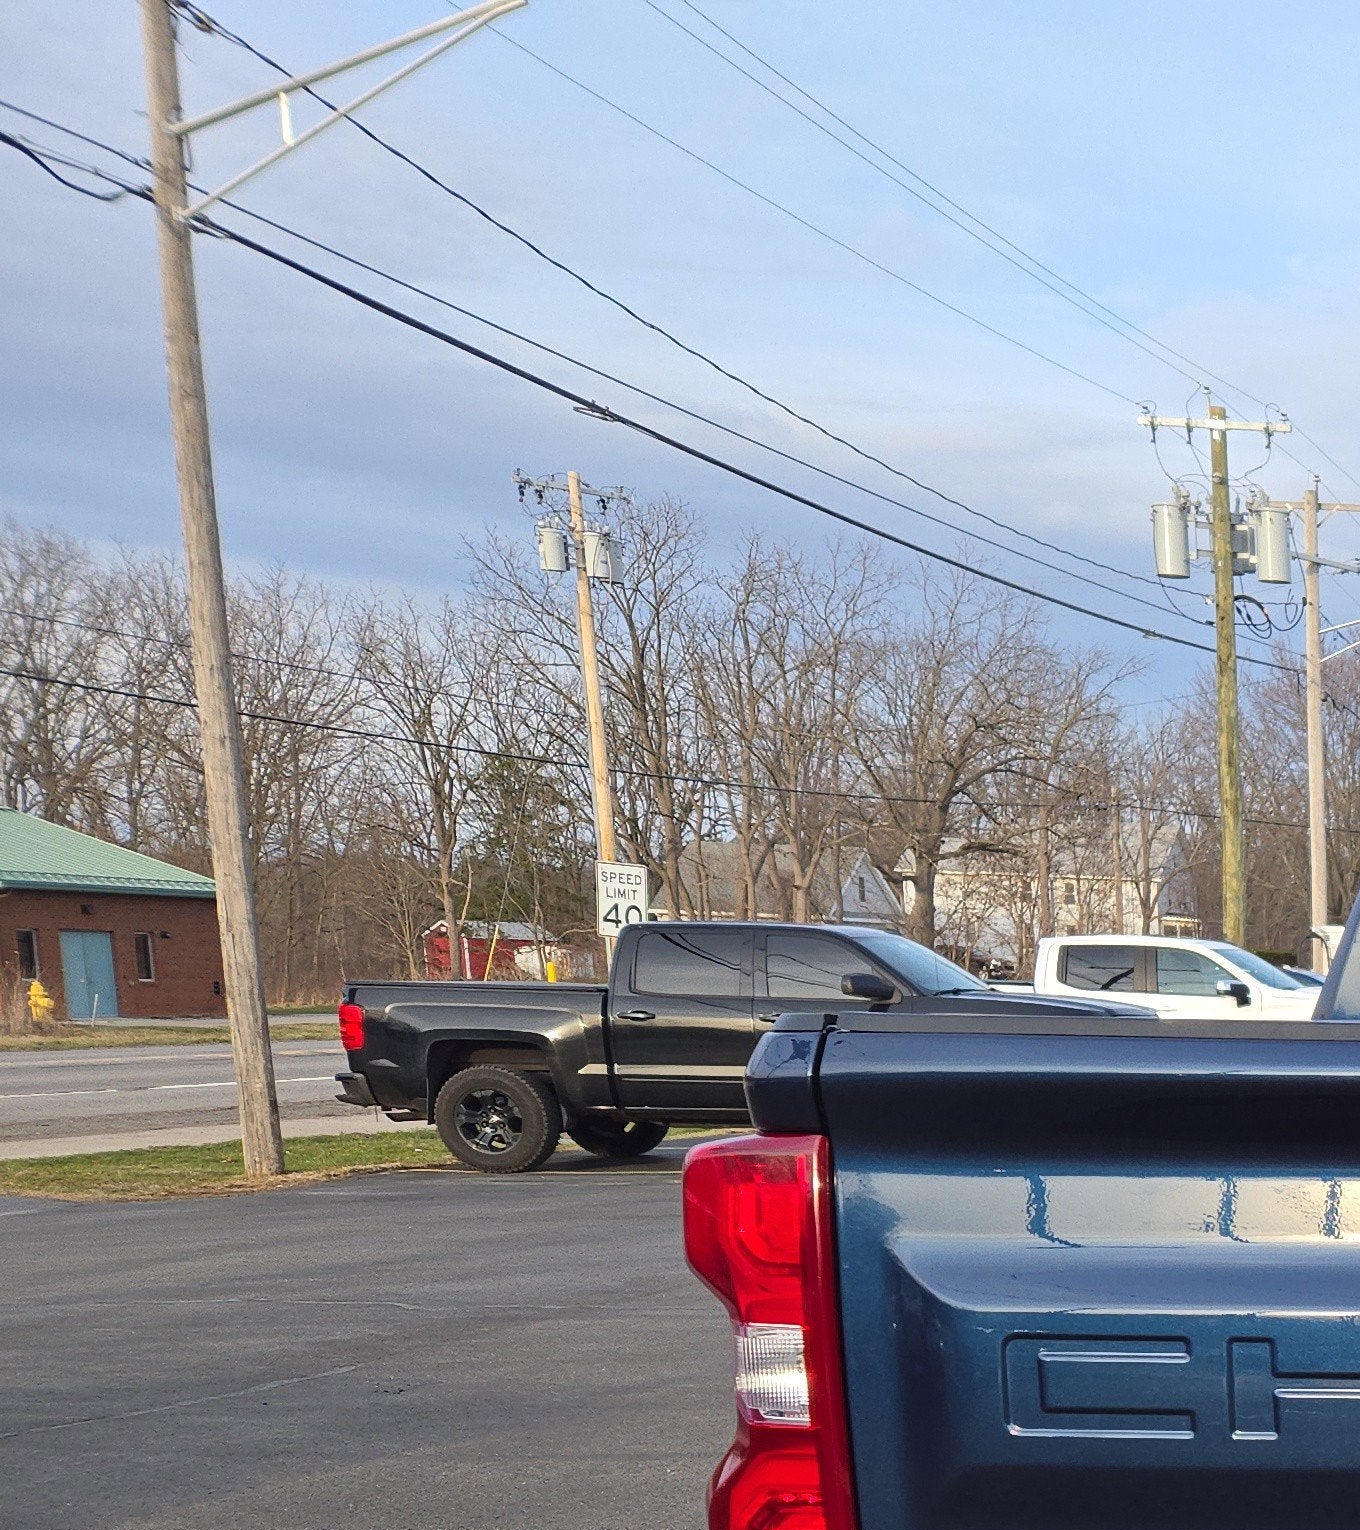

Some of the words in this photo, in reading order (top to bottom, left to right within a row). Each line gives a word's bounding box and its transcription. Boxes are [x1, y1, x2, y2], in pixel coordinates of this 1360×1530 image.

[601, 871, 642, 886] SPEED
[605, 887, 637, 900] LIMIT
[603, 903, 643, 929] 40
